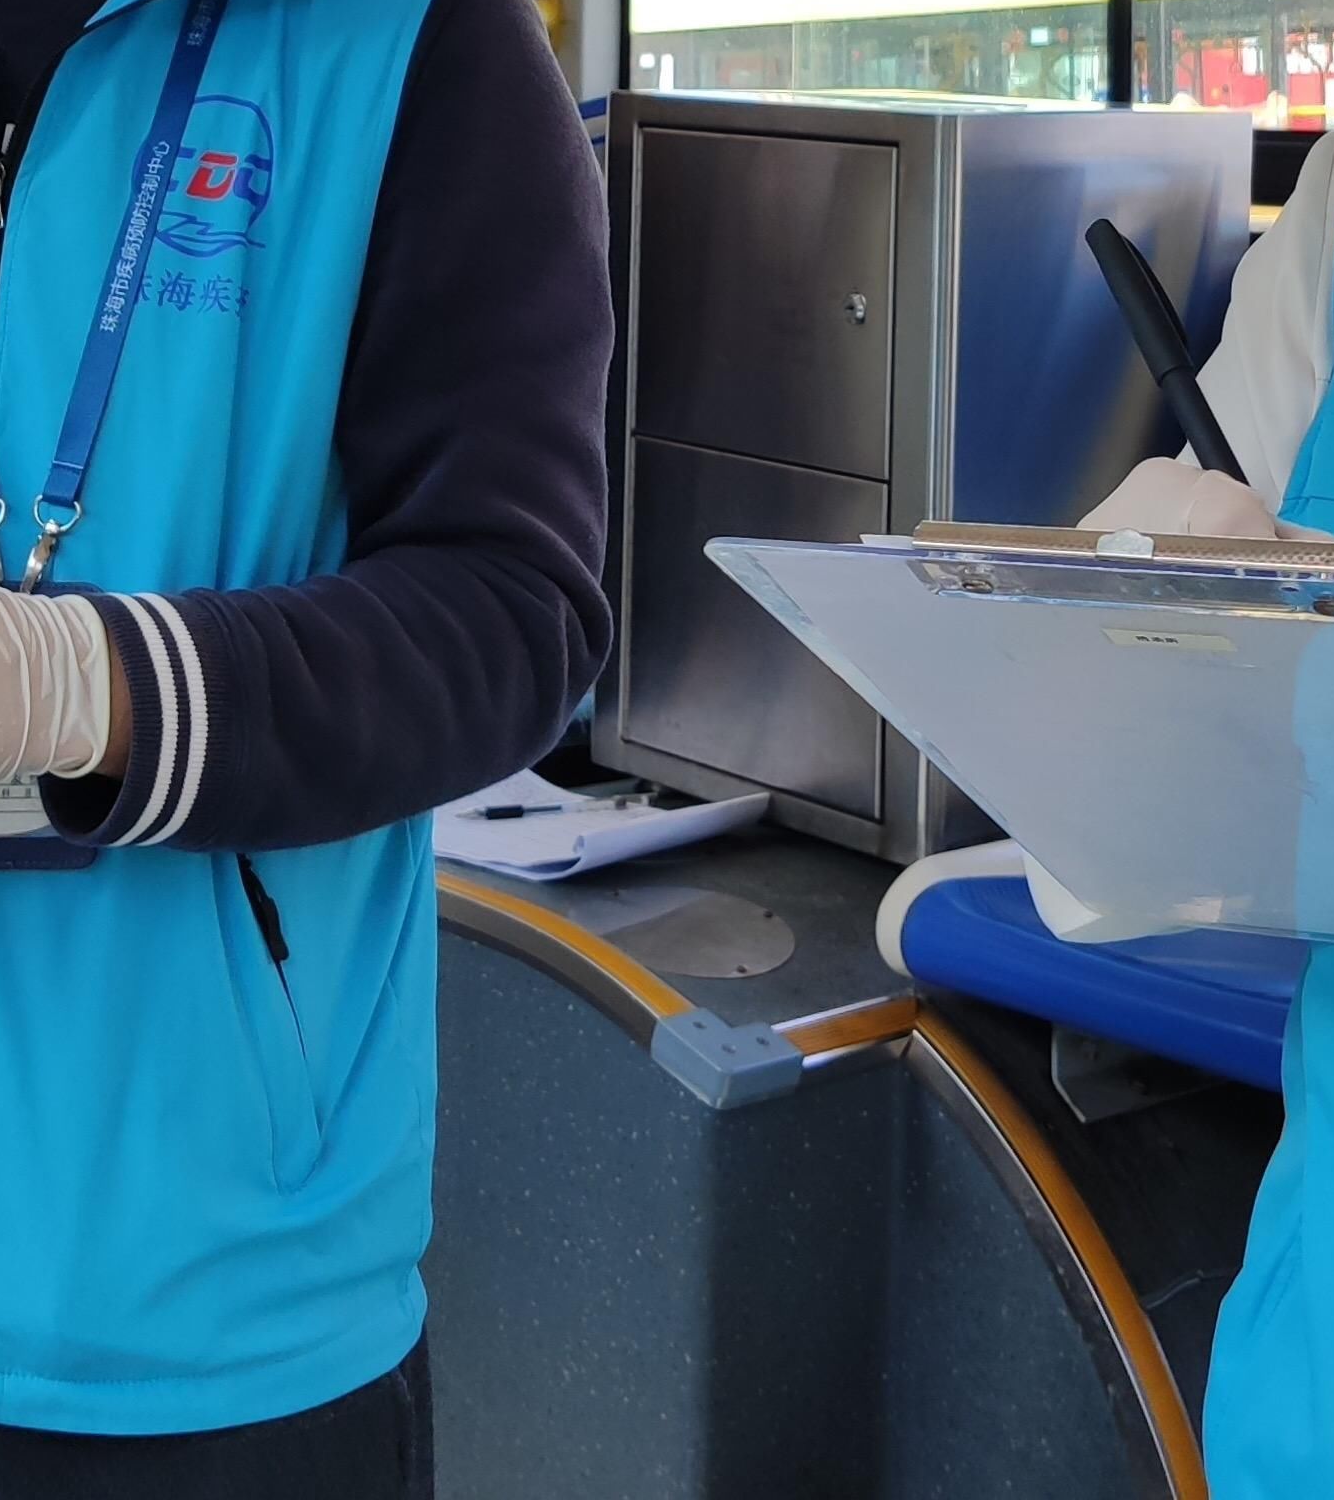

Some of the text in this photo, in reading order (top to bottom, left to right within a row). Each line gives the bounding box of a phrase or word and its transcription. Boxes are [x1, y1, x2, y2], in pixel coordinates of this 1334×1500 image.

[100, 140, 171, 334] 珠海市疾病预防控制中心
[137, 268, 251, 318] 海疾
